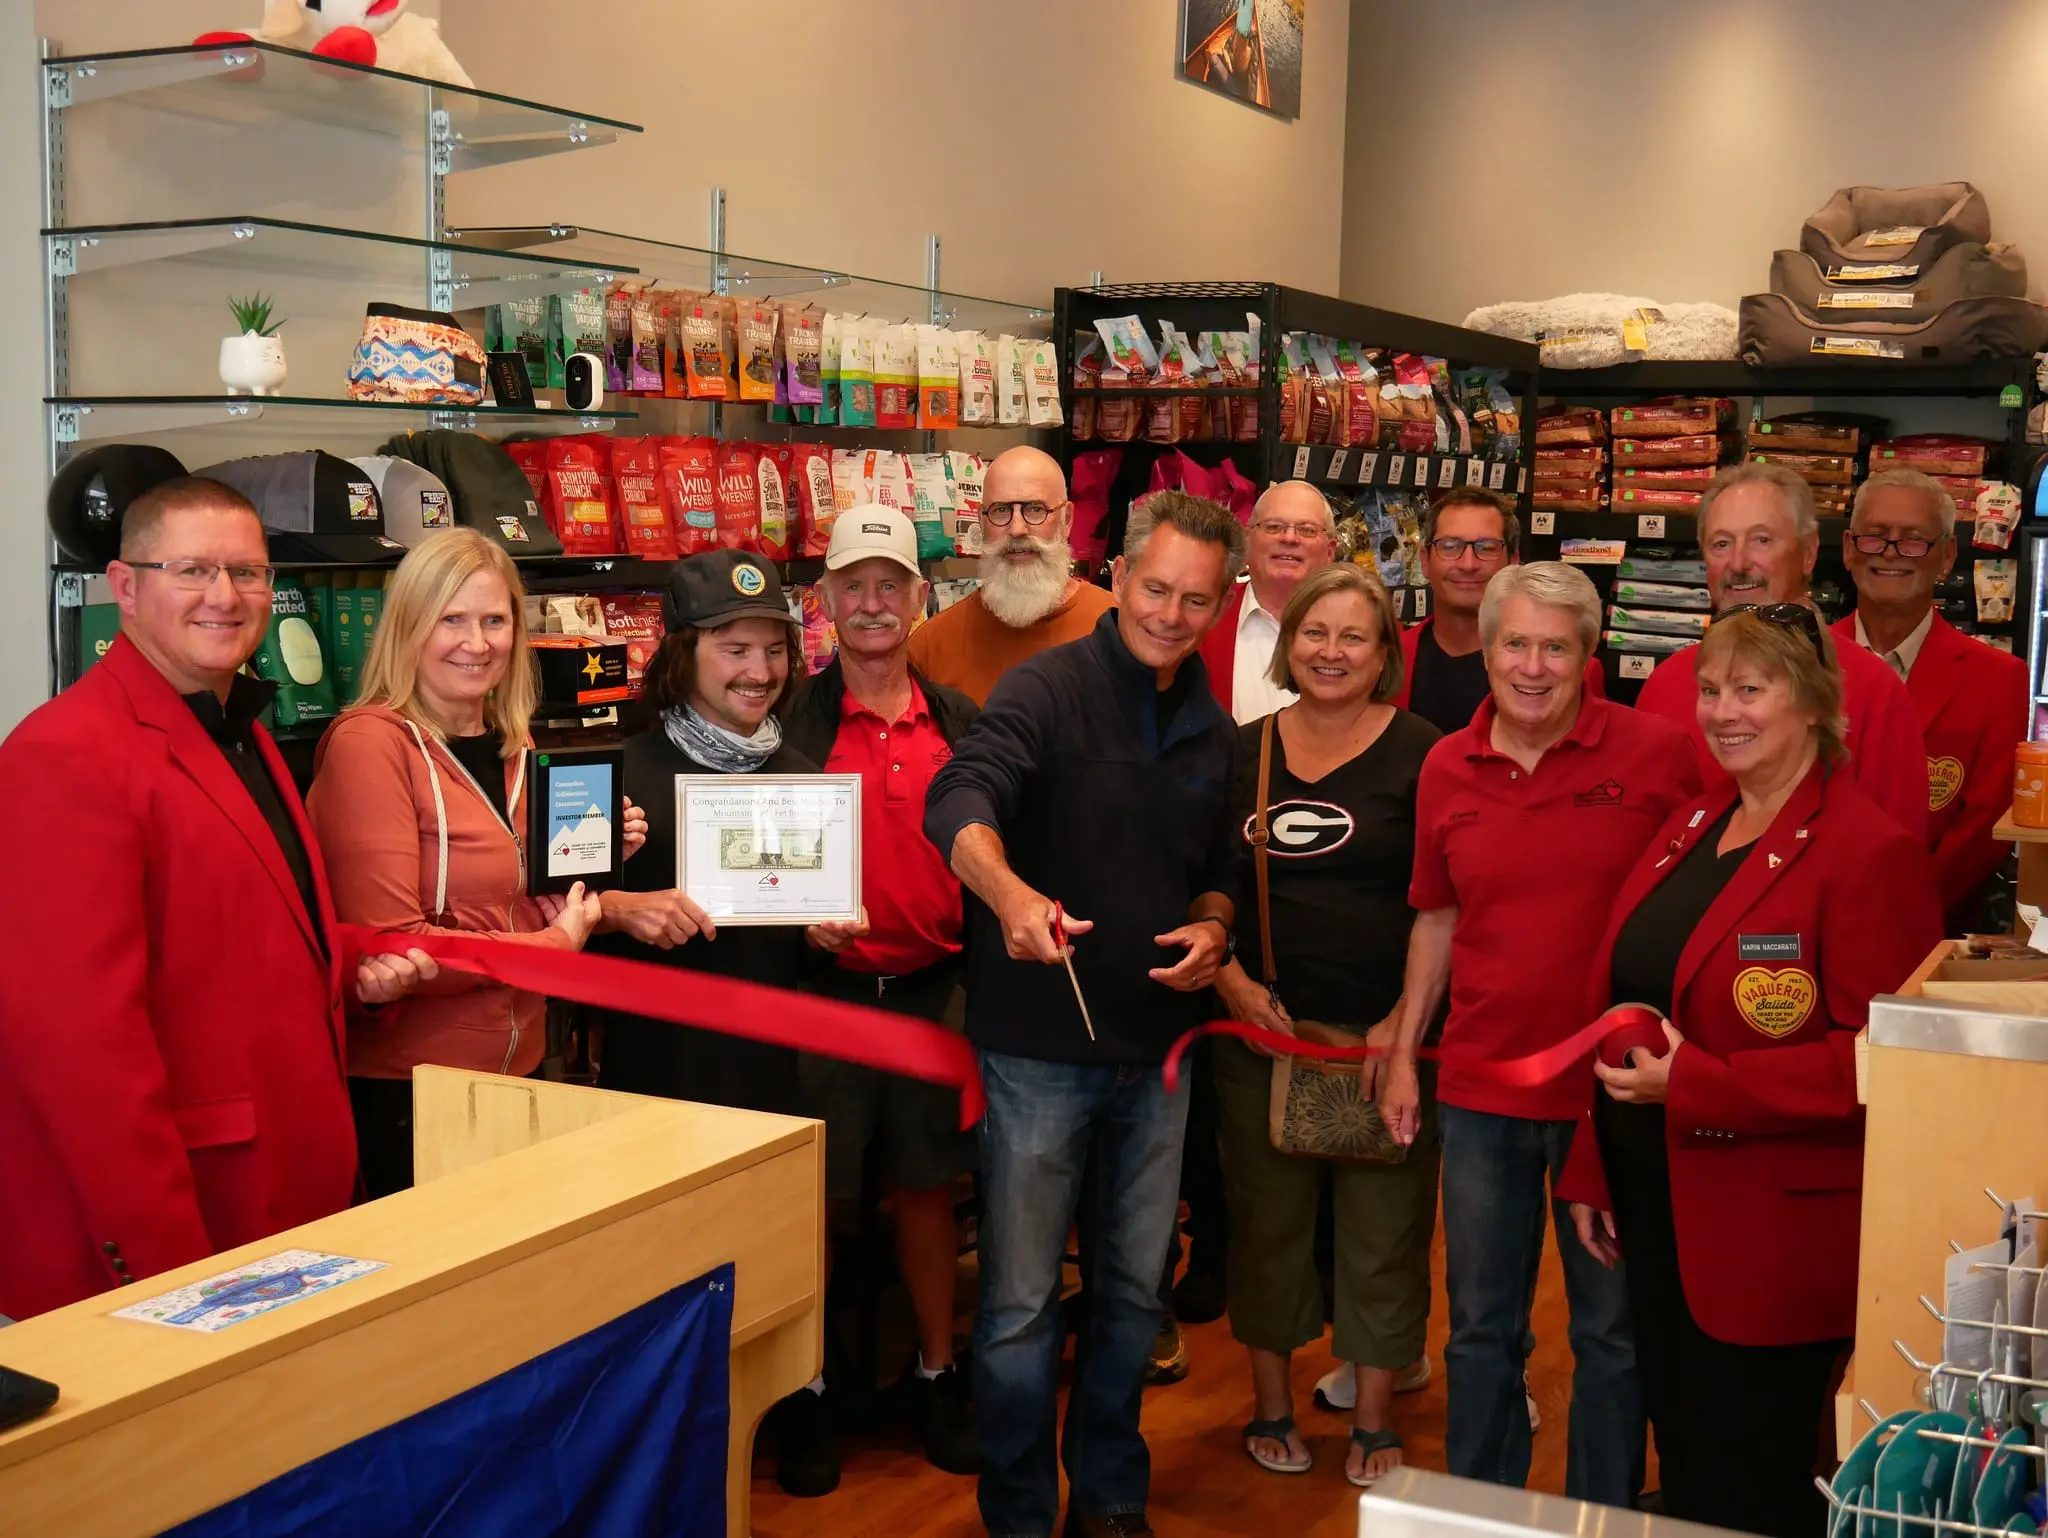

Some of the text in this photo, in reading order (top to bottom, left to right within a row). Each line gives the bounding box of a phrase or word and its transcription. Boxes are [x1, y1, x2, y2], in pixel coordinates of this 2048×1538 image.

[686, 317, 713, 328] TRICKY
[678, 469, 712, 494] WILD
[719, 467, 754, 491] WILD
[561, 484, 592, 498] CRUNCH
[958, 482, 983, 493] JERKY
[624, 490, 647, 503] CRUNCH
[272, 588, 304, 601] earth
[272, 600, 306, 614] rated
[834, 797, 846, 806] To
[555, 812, 606, 822] INVESTOR MEMBER
[1742, 943, 1798, 951] KARIN NACCARATO
[1741, 982, 1809, 1004] VAQUEROS
[1755, 997, 1797, 1012] Salida
